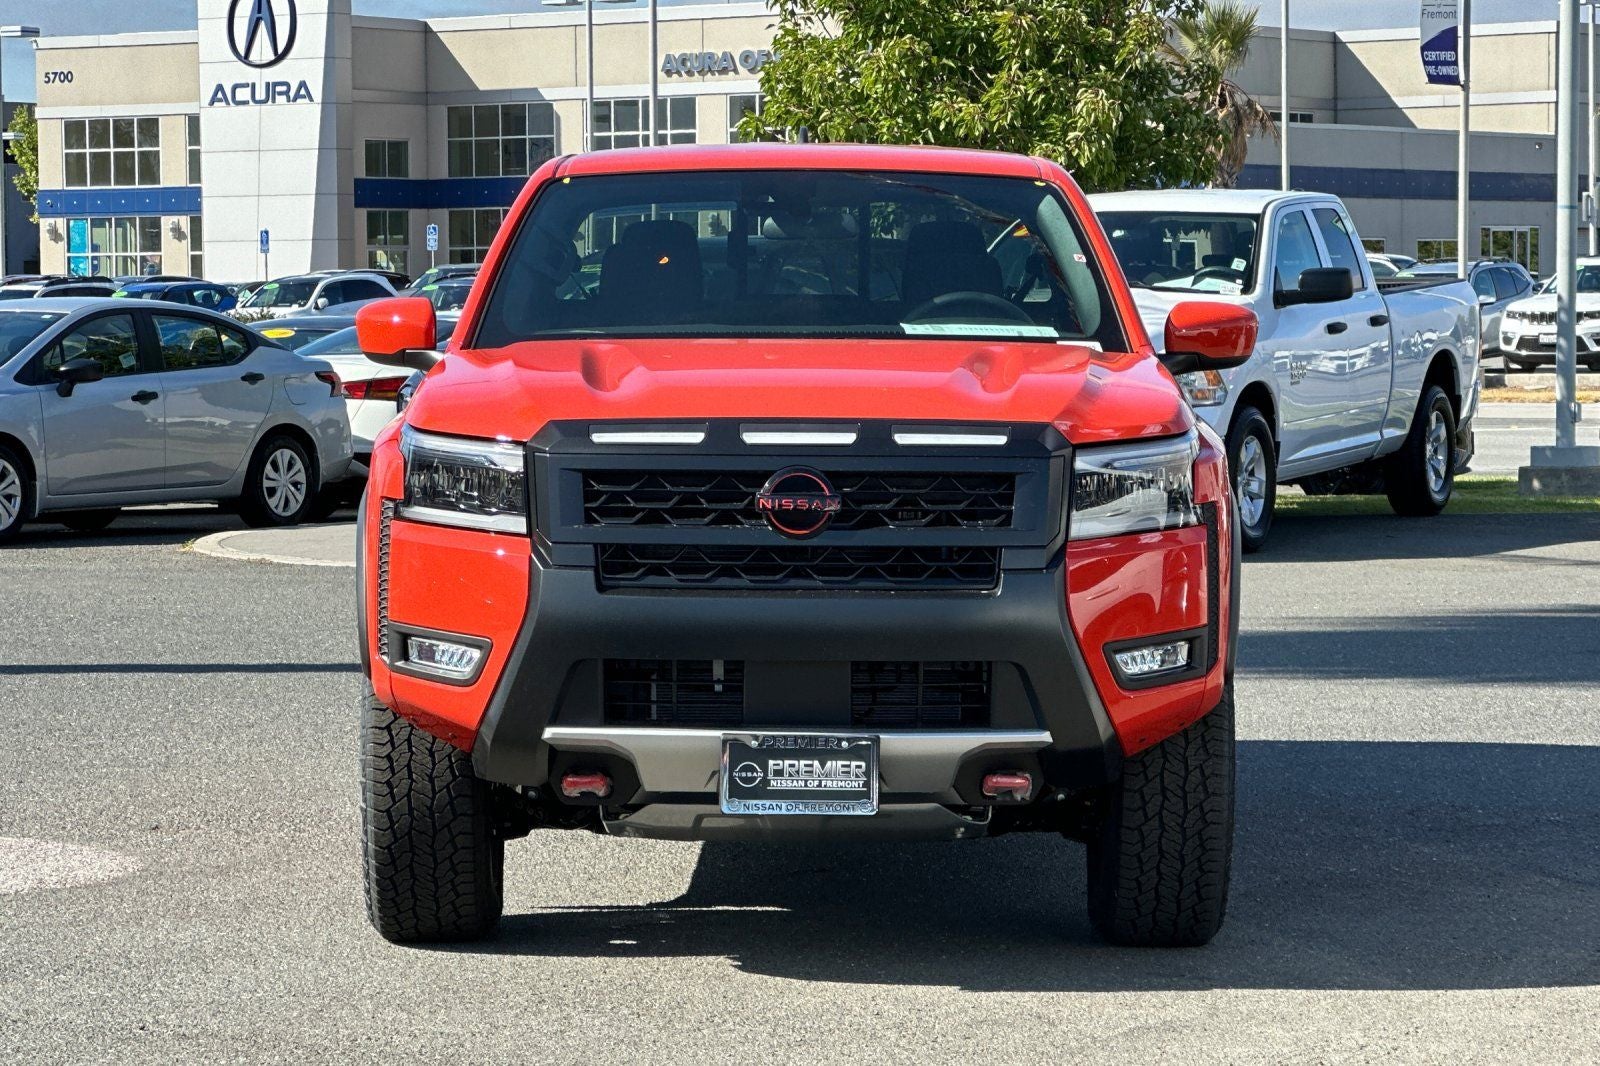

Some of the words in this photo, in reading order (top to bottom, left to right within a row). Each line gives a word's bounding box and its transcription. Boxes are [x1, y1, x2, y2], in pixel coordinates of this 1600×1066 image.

[1422, 9, 1457, 19] Fremont
[661, 51, 736, 73] ACURA
[739, 49, 768, 70] OF
[1423, 51, 1456, 61] CERTIFIED
[1425, 65, 1458, 76] PRE-OWNED
[44, 71, 74, 84] 5700
[207, 79, 315, 106] ACURA
[759, 498, 839, 511] NISSAN
[764, 737, 838, 749] PREMIER
[767, 760, 866, 778] PREMIER
[770, 780, 805, 788] NISSAN
[806, 780, 820, 788] OF
[821, 780, 864, 788] FREMONT
[742, 803, 783, 812] NISSAN
[785, 803, 800, 812] OF
[801, 803, 856, 812] FREMONT
